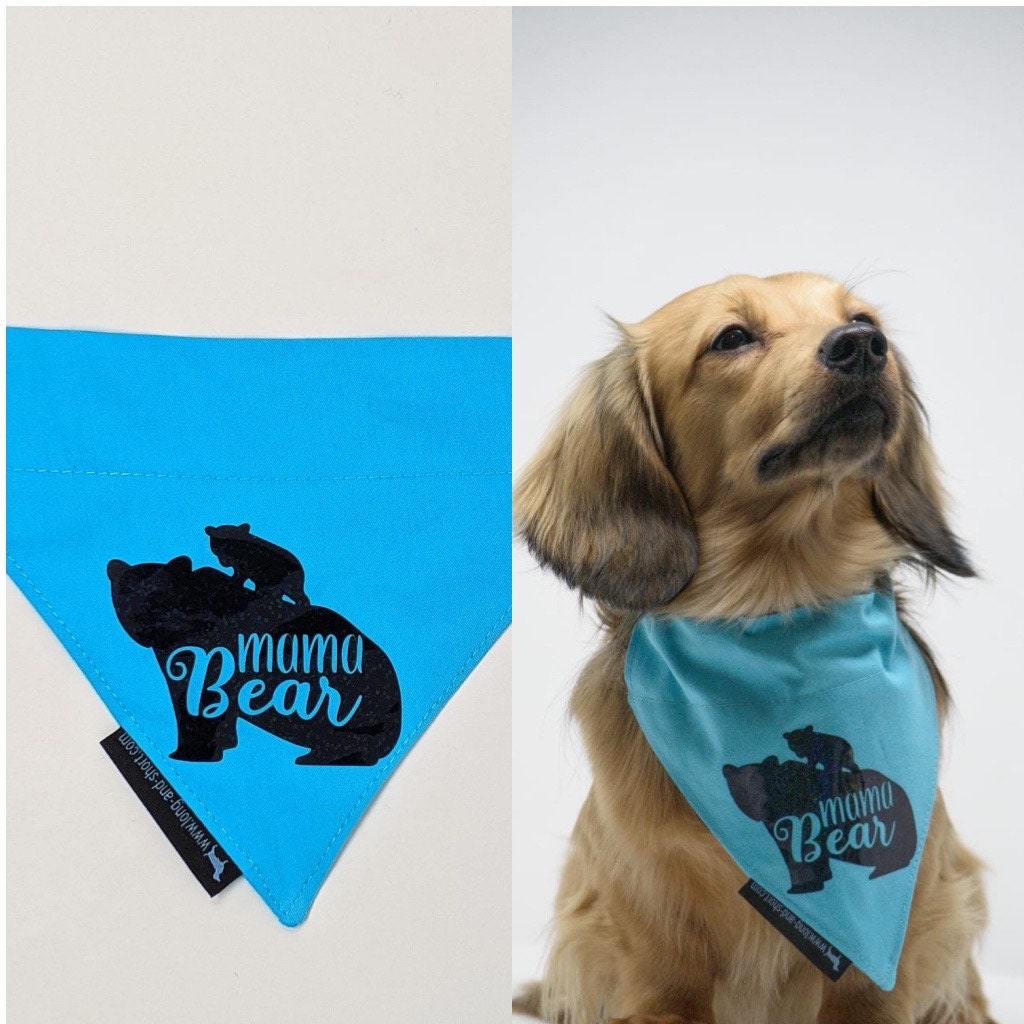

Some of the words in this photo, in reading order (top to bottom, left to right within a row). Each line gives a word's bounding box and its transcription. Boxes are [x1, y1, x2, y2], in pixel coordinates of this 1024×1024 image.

[237, 632, 364, 674] mama
[165, 644, 363, 728] Bear
[819, 779, 894, 827] mama
[773, 811, 896, 864] Bear
